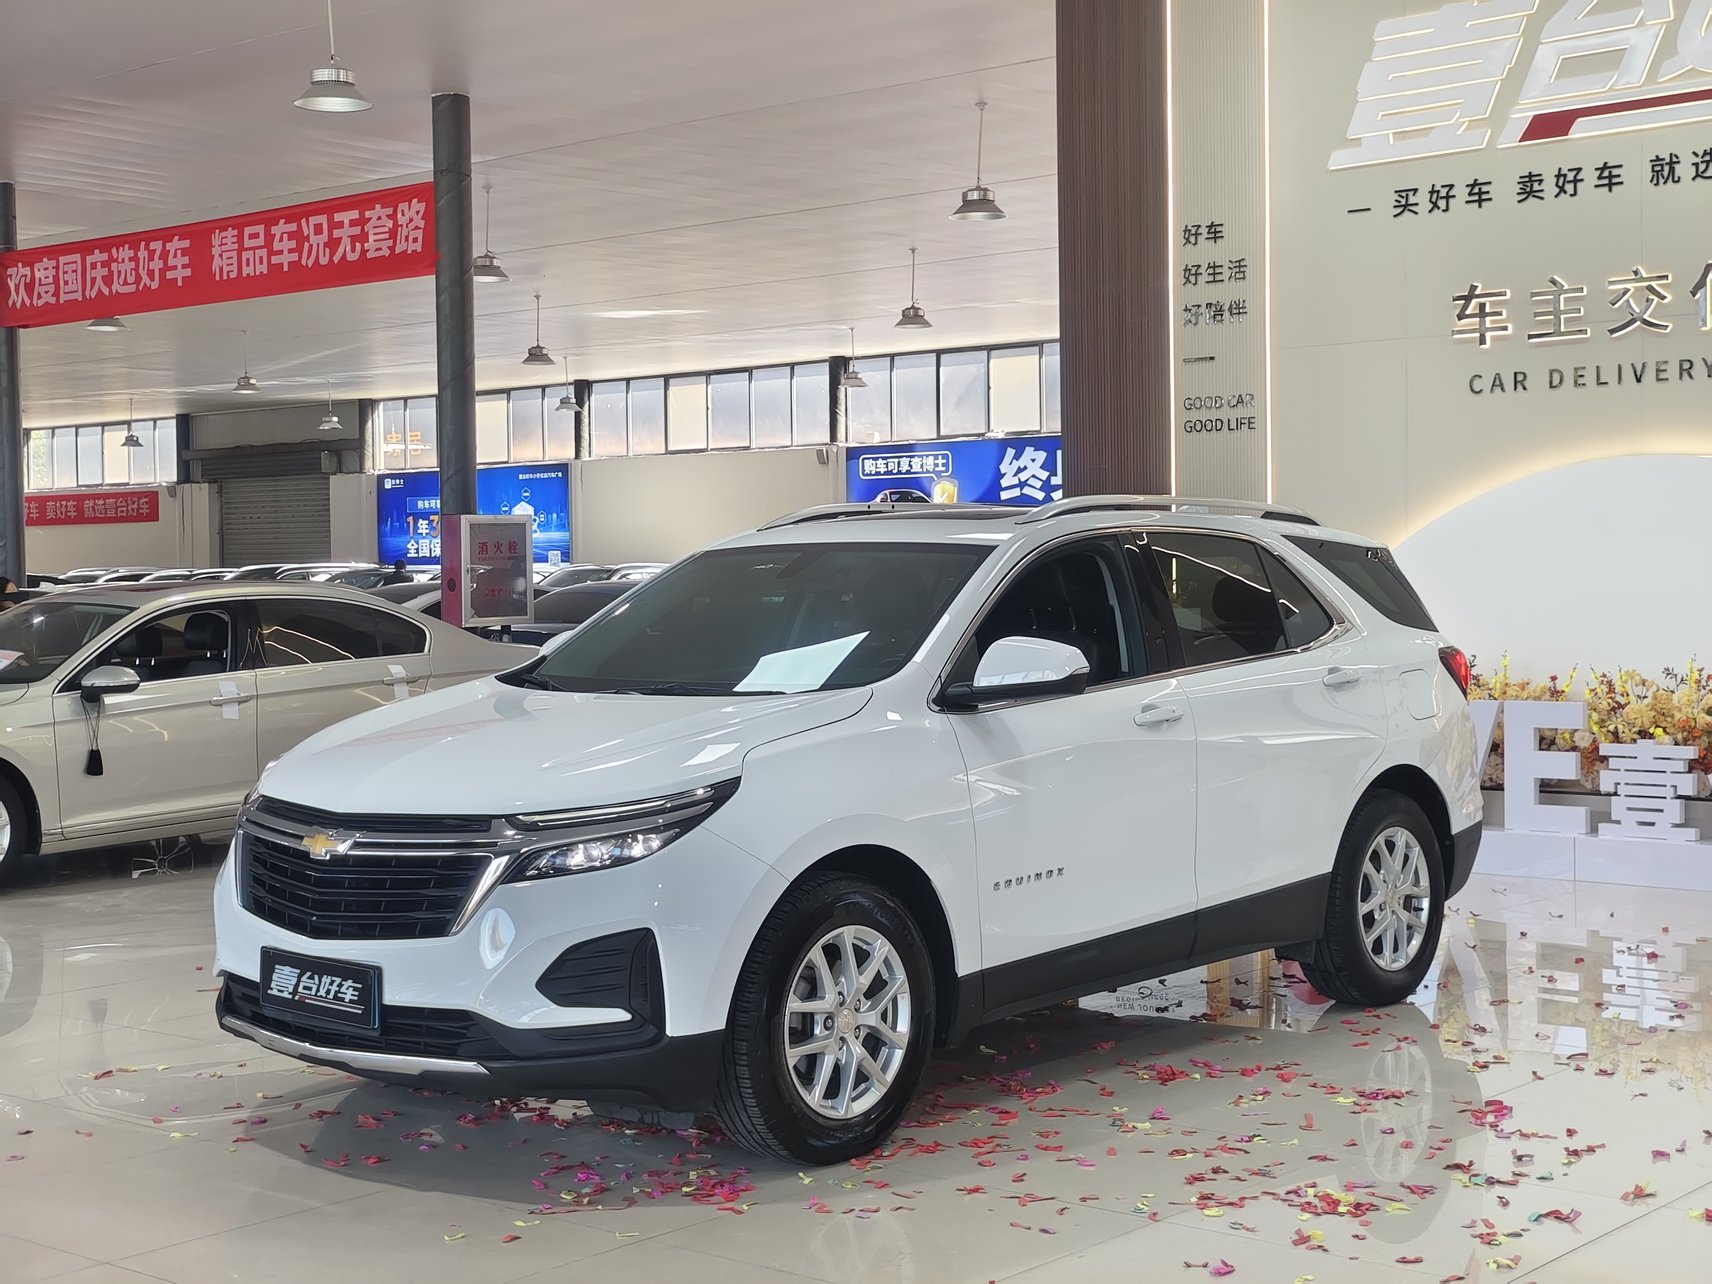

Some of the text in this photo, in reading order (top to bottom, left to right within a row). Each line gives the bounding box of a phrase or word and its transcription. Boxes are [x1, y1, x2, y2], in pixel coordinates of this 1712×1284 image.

[1392, 179, 1493, 218] 买好车
[1516, 162, 1625, 204] 卖好车
[1182, 221, 1224, 246] 好车
[6, 198, 427, 309] 欢度国庆选好车 精品车况无套路
[1182, 258, 1248, 286] 好生活
[1183, 299, 1248, 326] 好陪伴
[1469, 366, 1528, 394] CAR
[1183, 393, 1255, 411] GOOD CAR
[1183, 416, 1256, 433] GOOD LIFE
[863, 456, 947, 475] 购车可享查博士
[46, 499, 77, 520] 卖好车
[84, 497, 150, 519] 就选壹台好车
[478, 541, 518, 556] 消火栓
[993, 867, 1065, 891] EQUINOX
[267, 964, 363, 1003] 壹台好车
